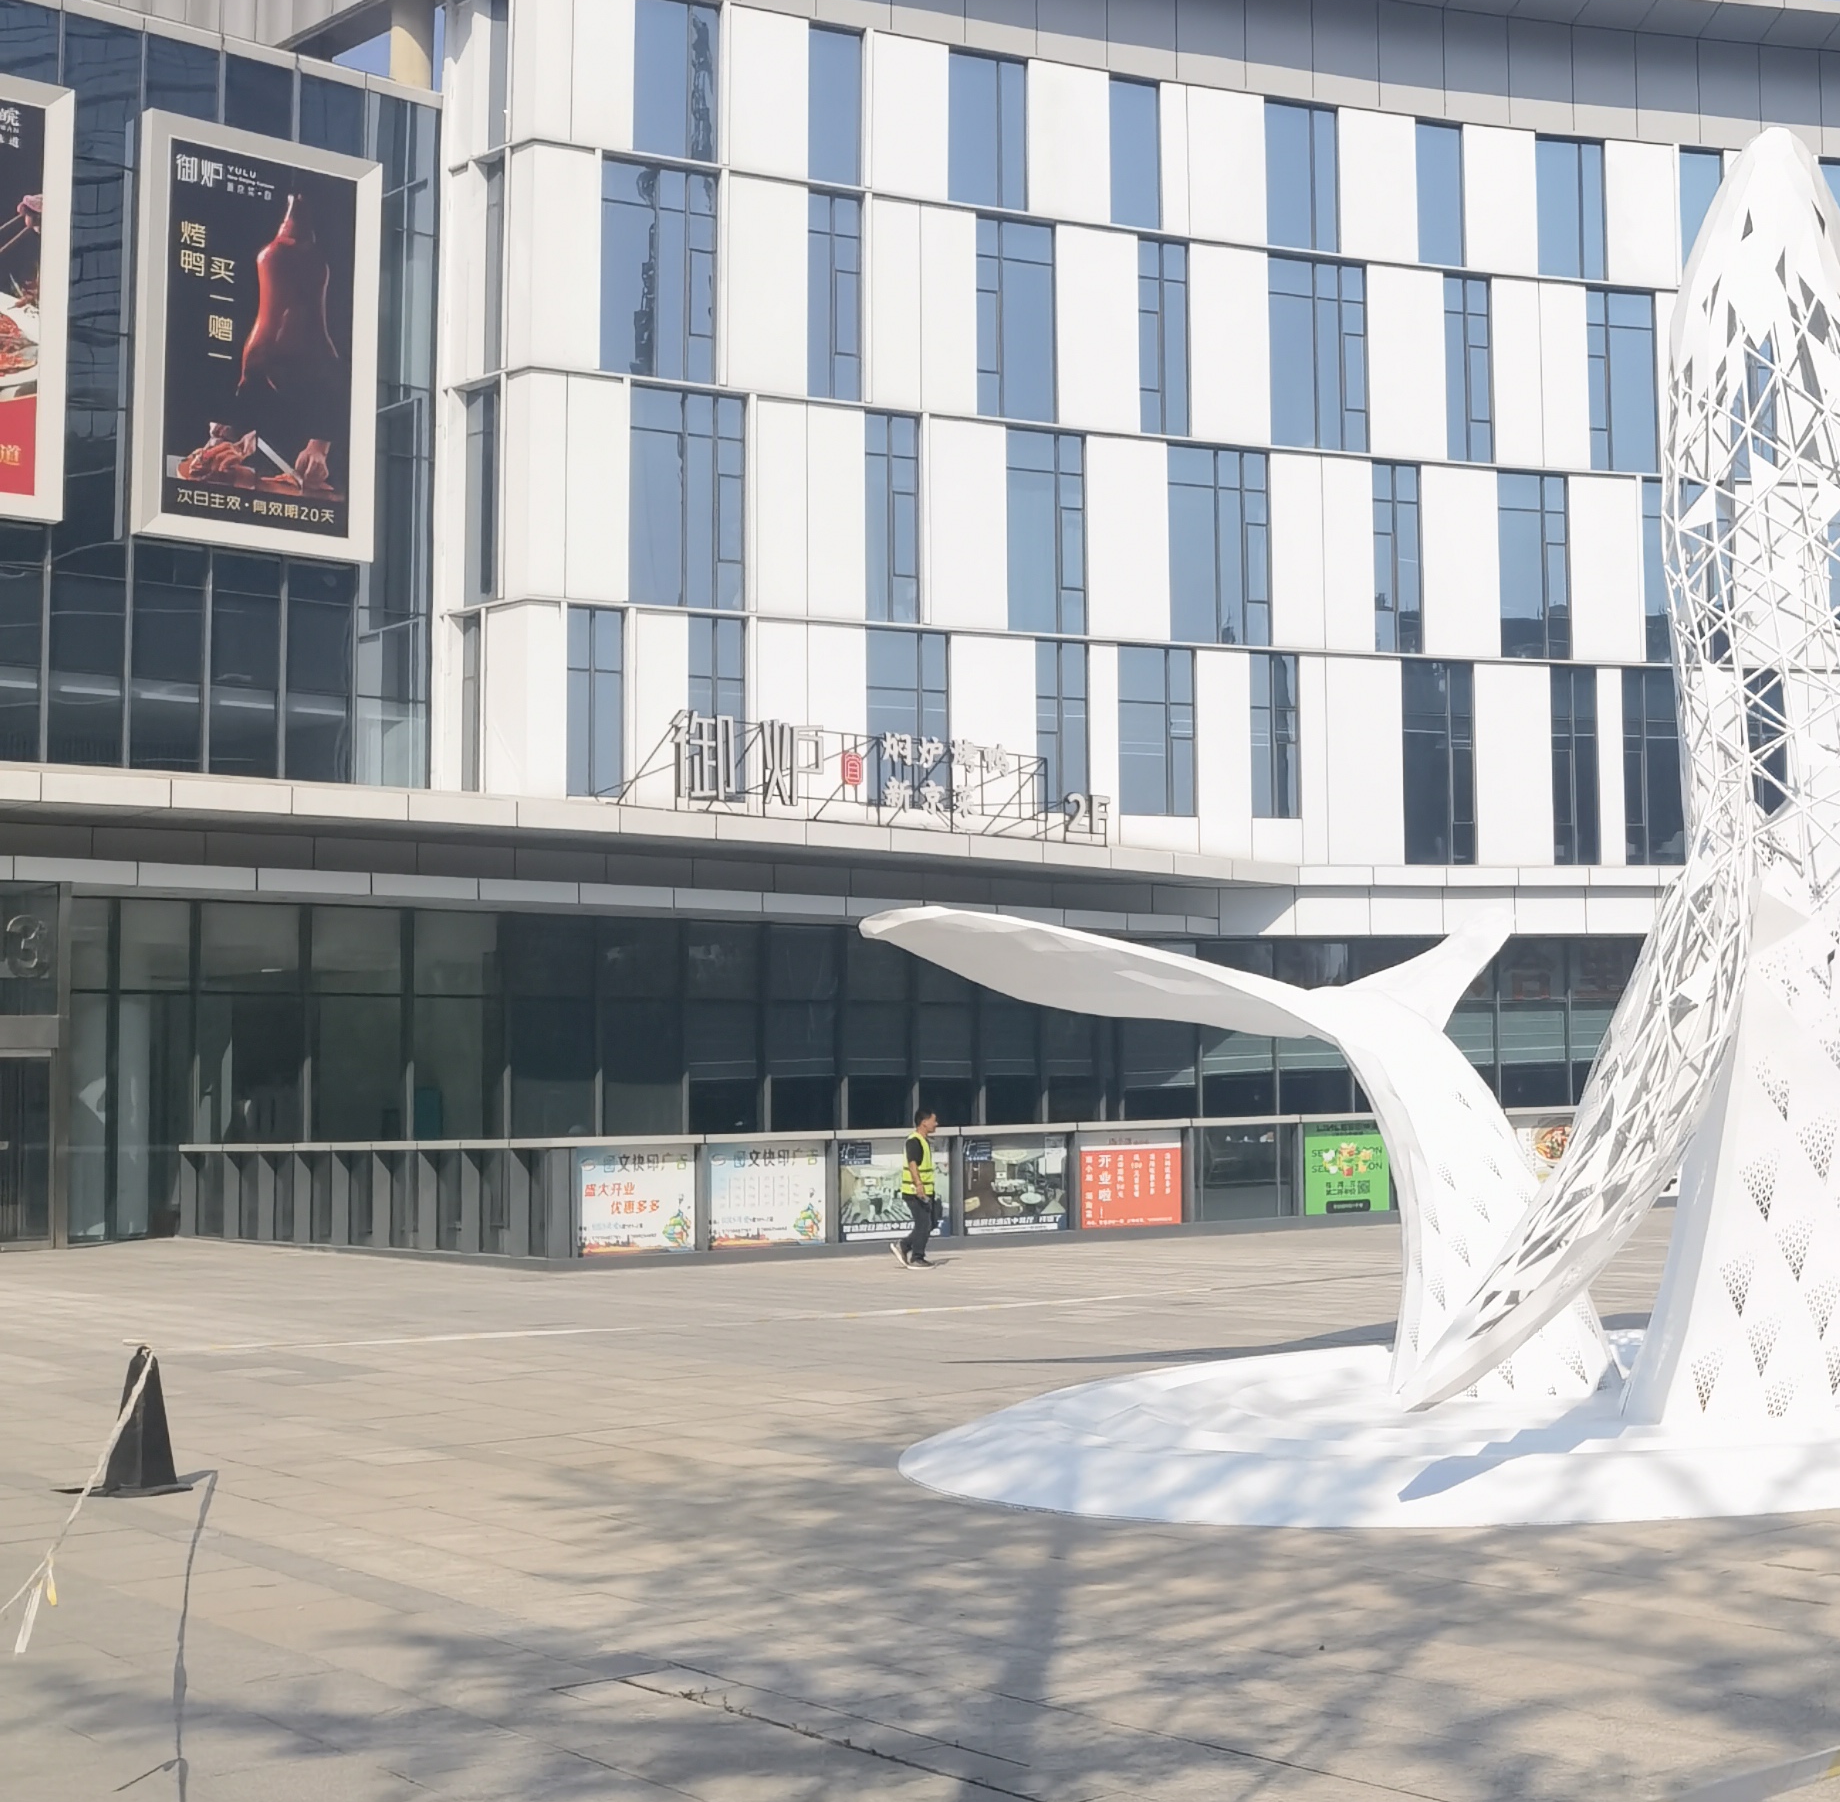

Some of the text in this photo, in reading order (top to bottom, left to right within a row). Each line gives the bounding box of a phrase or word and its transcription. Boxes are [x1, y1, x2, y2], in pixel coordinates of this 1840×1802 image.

[176, 154, 223, 188] 御炉
[227, 165, 257, 179] YULU
[180, 220, 207, 277] 烤鸭
[207, 256, 235, 360] 买一赠一
[669, 709, 824, 806] 御炉
[883, 731, 1010, 777] 焖炉烤鸭
[883, 776, 978, 819] 新京菜
[1064, 792, 1110, 834] 2F
[585, 1182, 636, 1198] 盛大开业
[611, 1199, 660, 1215] 优惠多多
